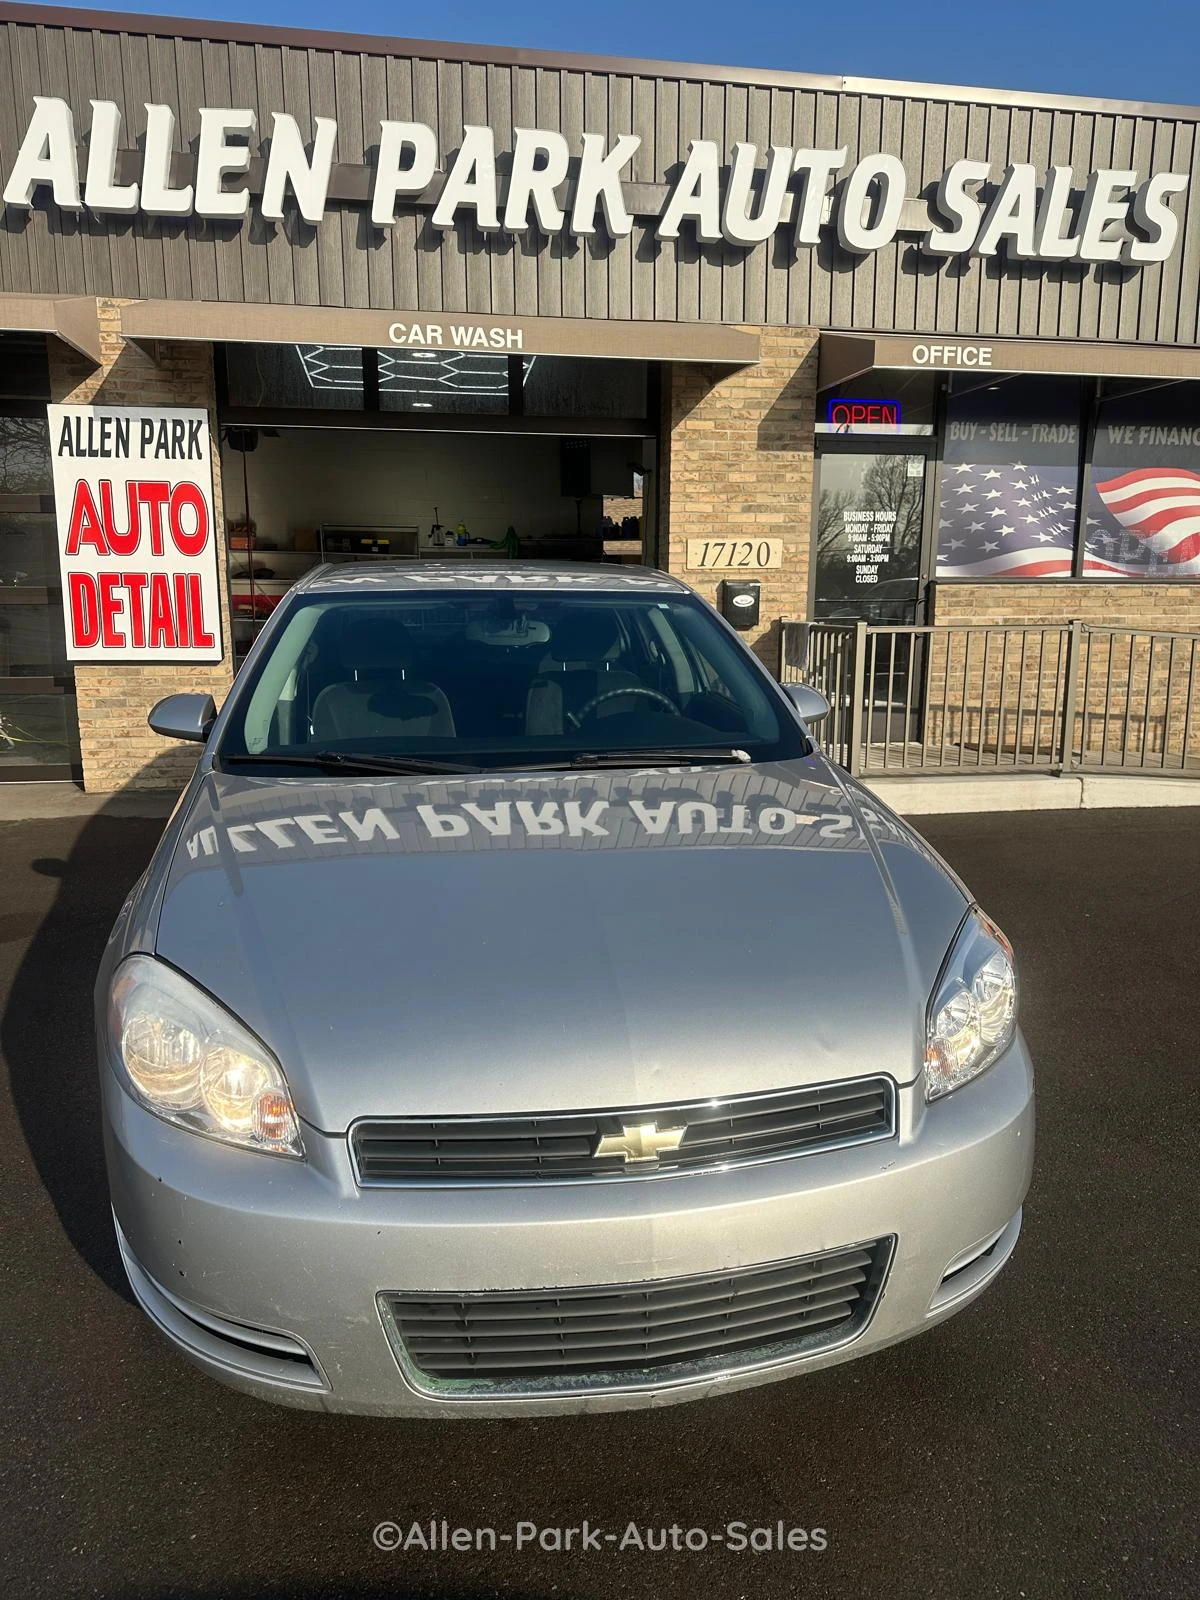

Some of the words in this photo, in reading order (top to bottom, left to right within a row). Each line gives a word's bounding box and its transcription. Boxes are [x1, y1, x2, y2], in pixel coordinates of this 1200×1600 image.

[3, 95, 337, 226] ALLEN
[371, 120, 641, 238] PARK
[655, 139, 907, 255] AUTO
[922, 159, 1189, 266] SALES
[389, 323, 443, 345] CAR
[450, 325, 523, 349] WASH
[912, 344, 993, 366] OFFICE
[832, 404, 897, 430] OPEN
[58, 416, 130, 459] ALLEN
[140, 417, 203, 460] PARK
[949, 421, 978, 441] BUY
[989, 422, 1019, 442] SELL
[1031, 424, 1077, 444] TRADE
[1107, 425, 1136, 444] WE
[65, 479, 209, 556] AUTO
[843, 511, 874, 521] BUSINESS
[875, 511, 896, 521] HOURS
[844, 523, 868, 533] MONDAY
[873, 523, 893, 533] FRIDAY
[697, 542, 770, 567] 17120
[853, 544, 883, 553] SATURDAY
[855, 575, 878, 583] CLOSED
[856, 565, 878, 574] SUNDAY
[68, 572, 215, 648] DETAIL
